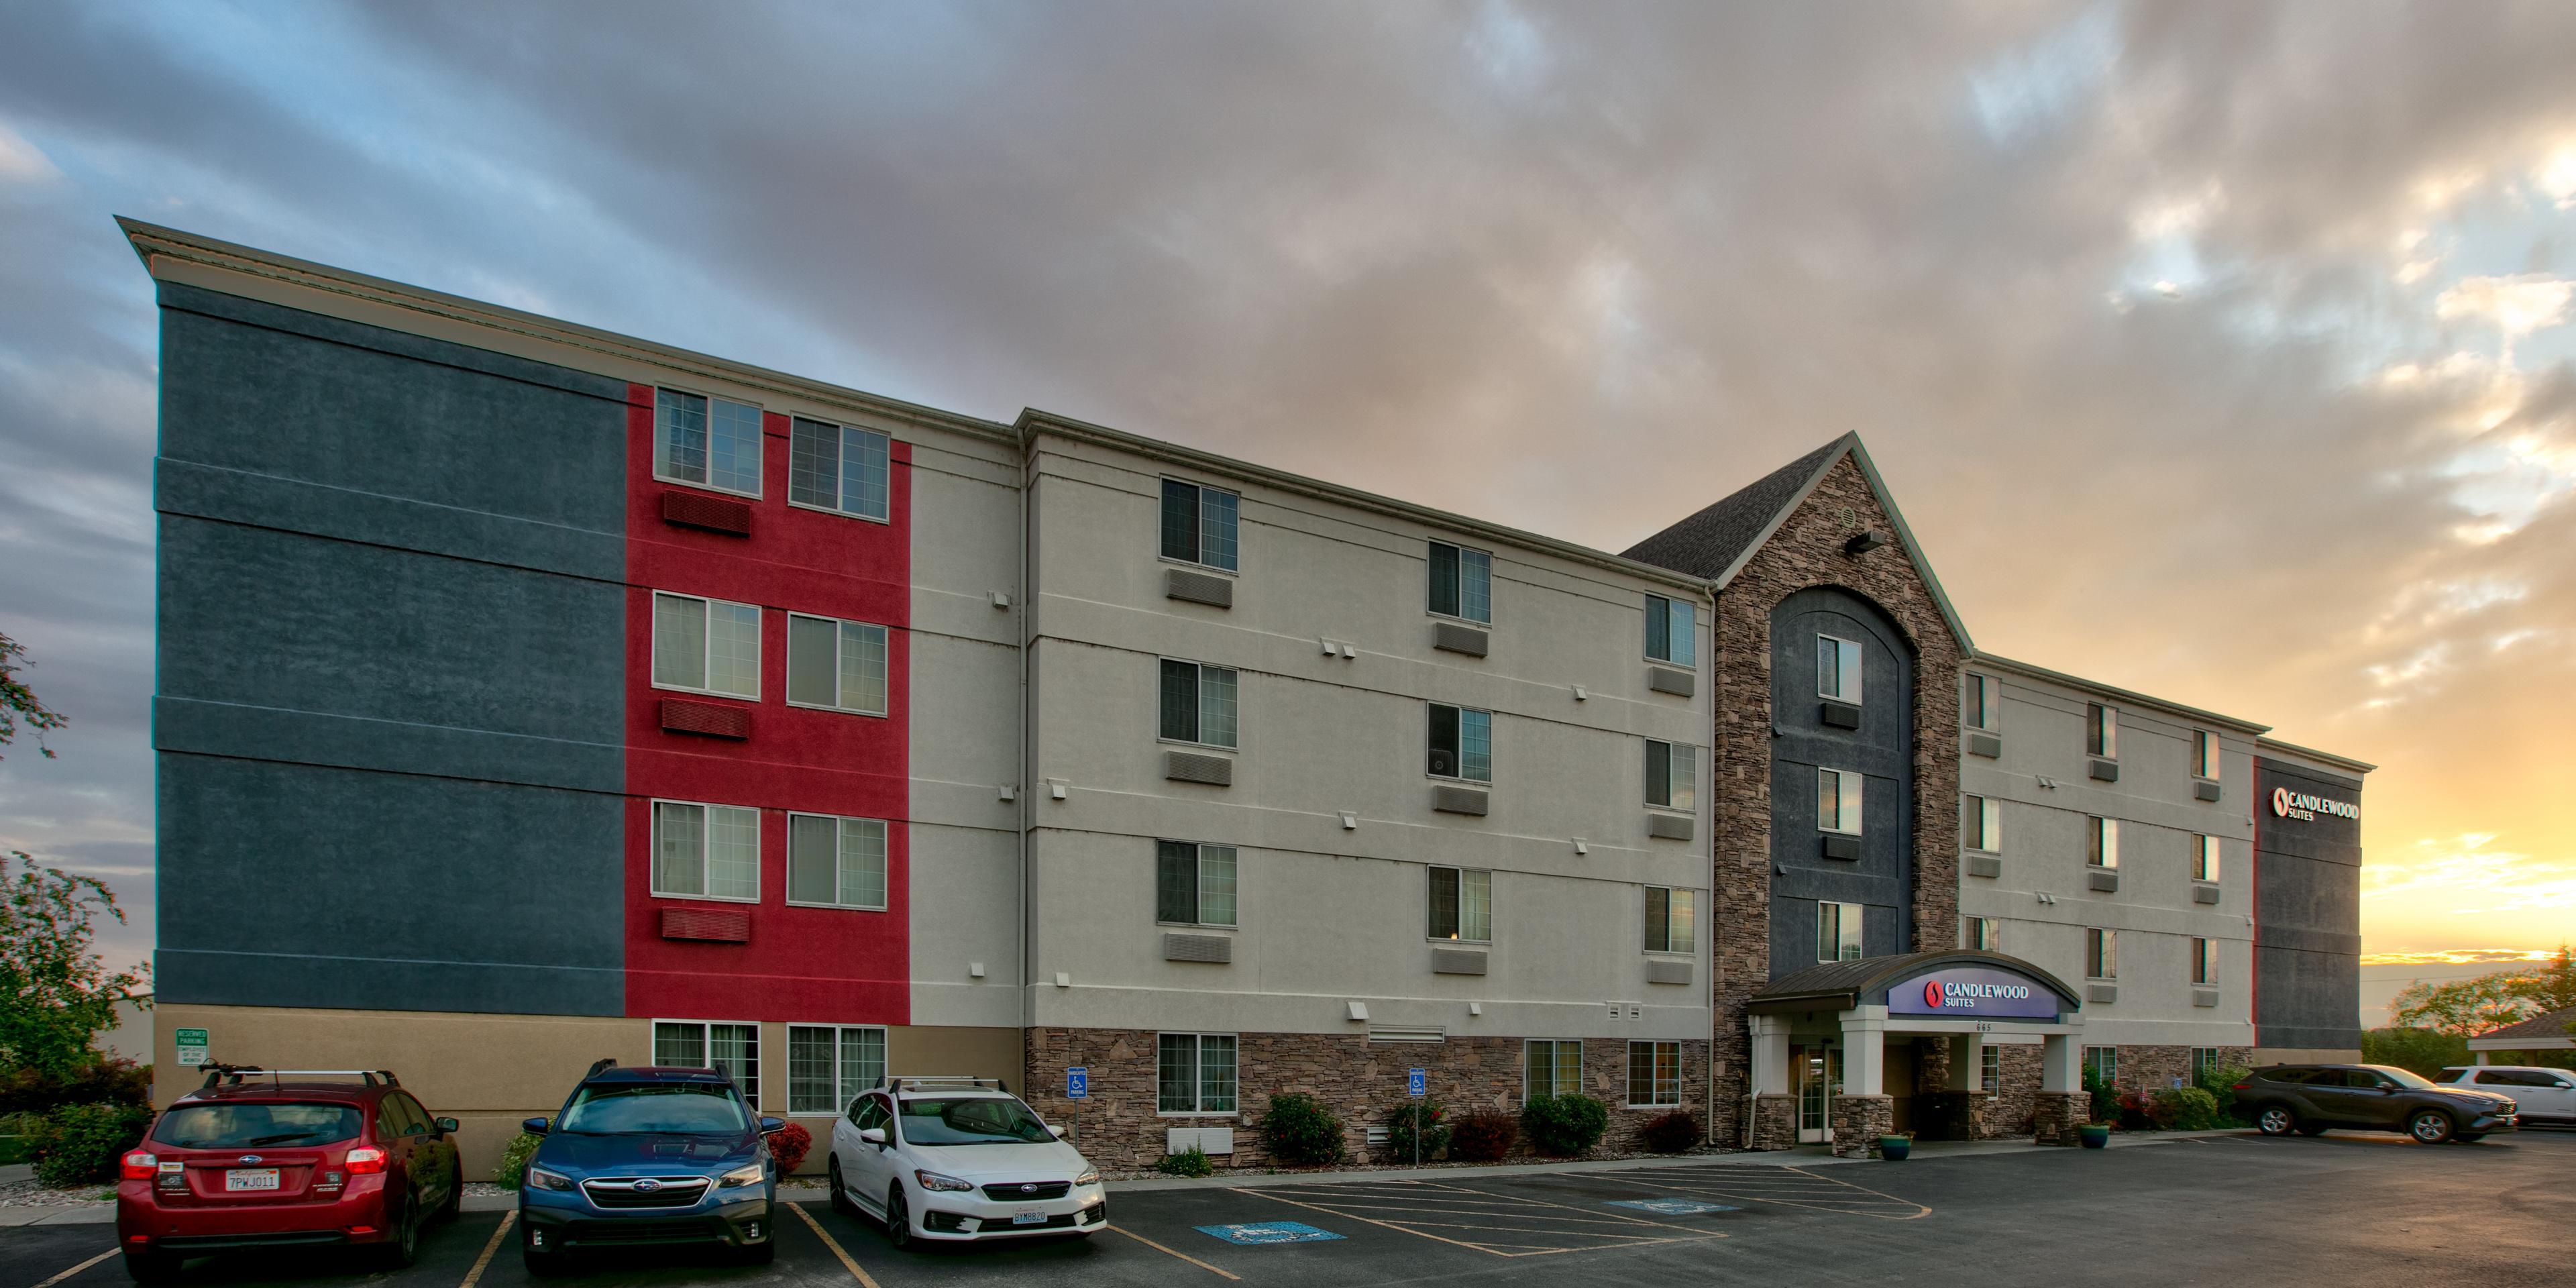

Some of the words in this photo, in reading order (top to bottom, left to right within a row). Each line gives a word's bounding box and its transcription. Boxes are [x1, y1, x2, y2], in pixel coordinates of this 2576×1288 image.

[2288, 792, 2359, 819] CANDLEWOOD
[2288, 808, 2314, 821] SUITES
[1945, 983, 2029, 999] CANDLEWOOD
[1945, 998, 1974, 1008] SUITES
[1976, 1023, 1991, 1032] 665
[229, 1177, 275, 1188] 7PWJ011
